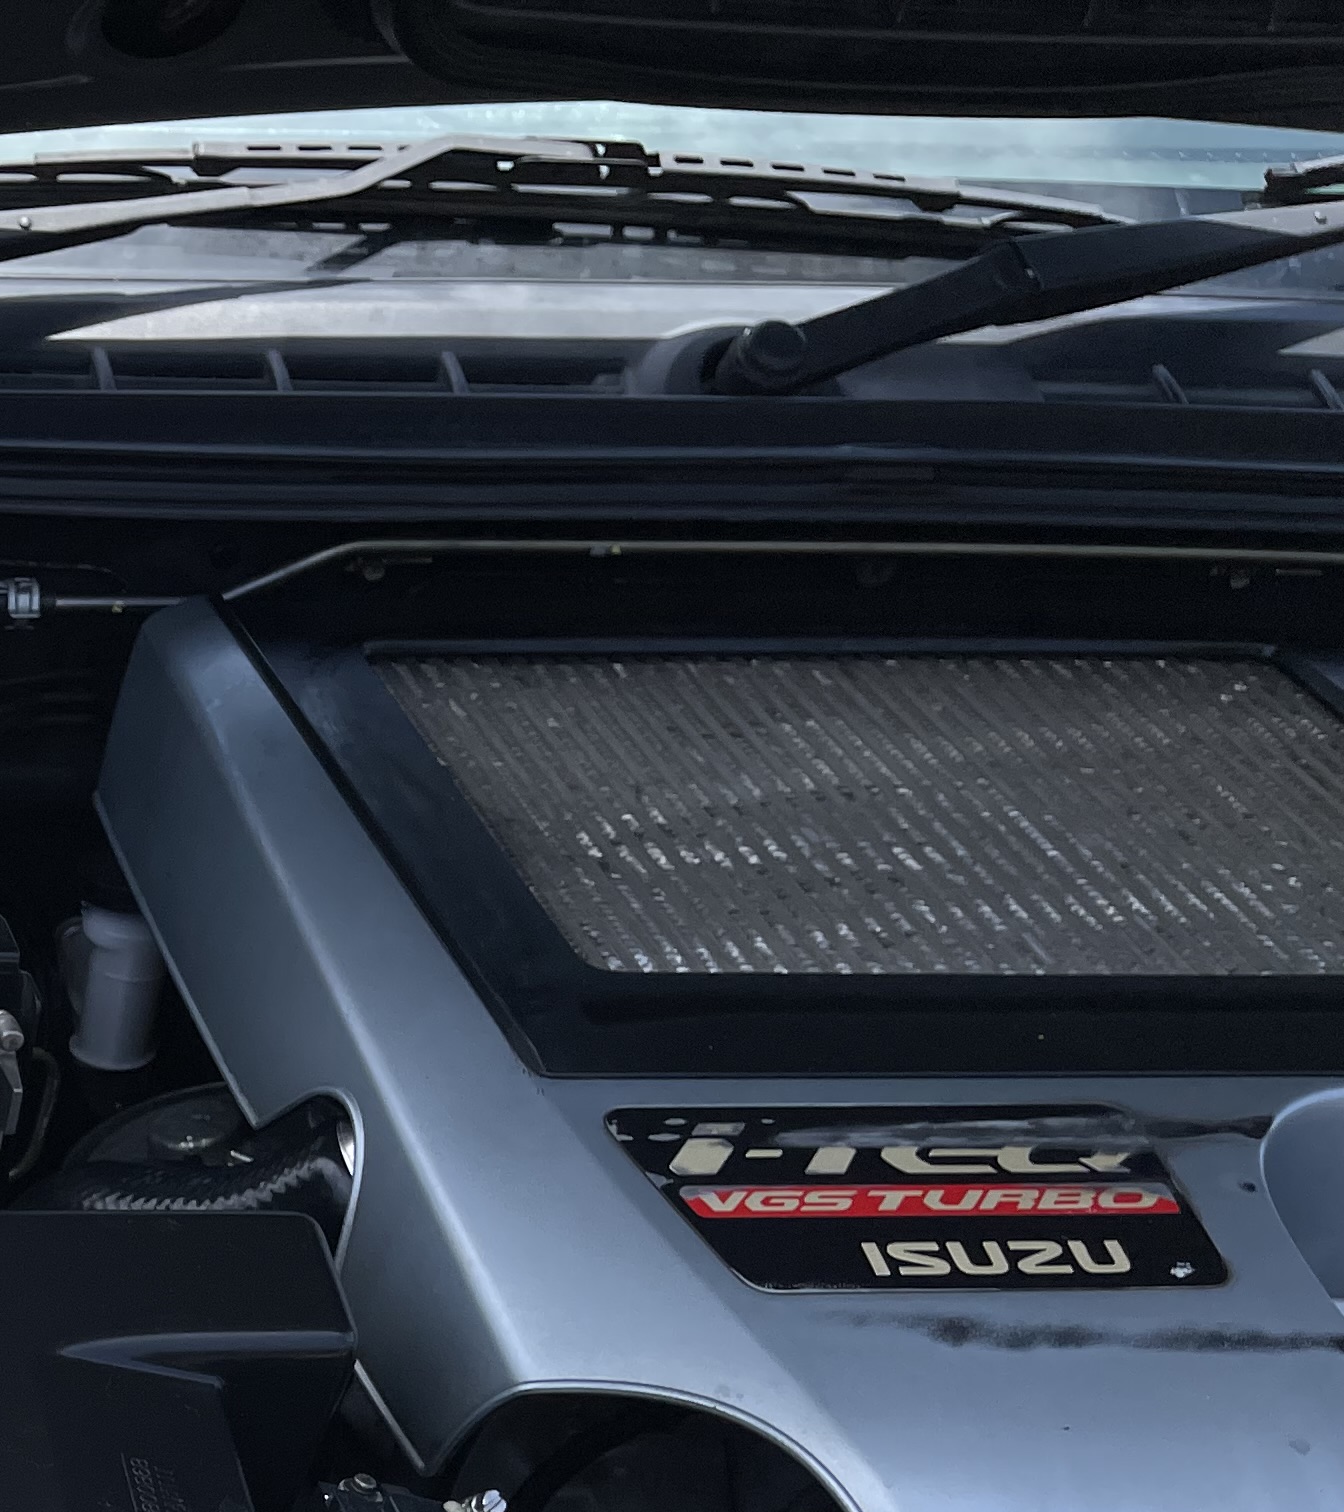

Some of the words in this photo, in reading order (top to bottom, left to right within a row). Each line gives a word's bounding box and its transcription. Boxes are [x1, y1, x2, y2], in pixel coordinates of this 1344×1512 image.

[698, 1187, 861, 1213] VGS
[866, 1186, 1160, 1212] TURBO
[860, 1239, 1132, 1277] ISUZU
